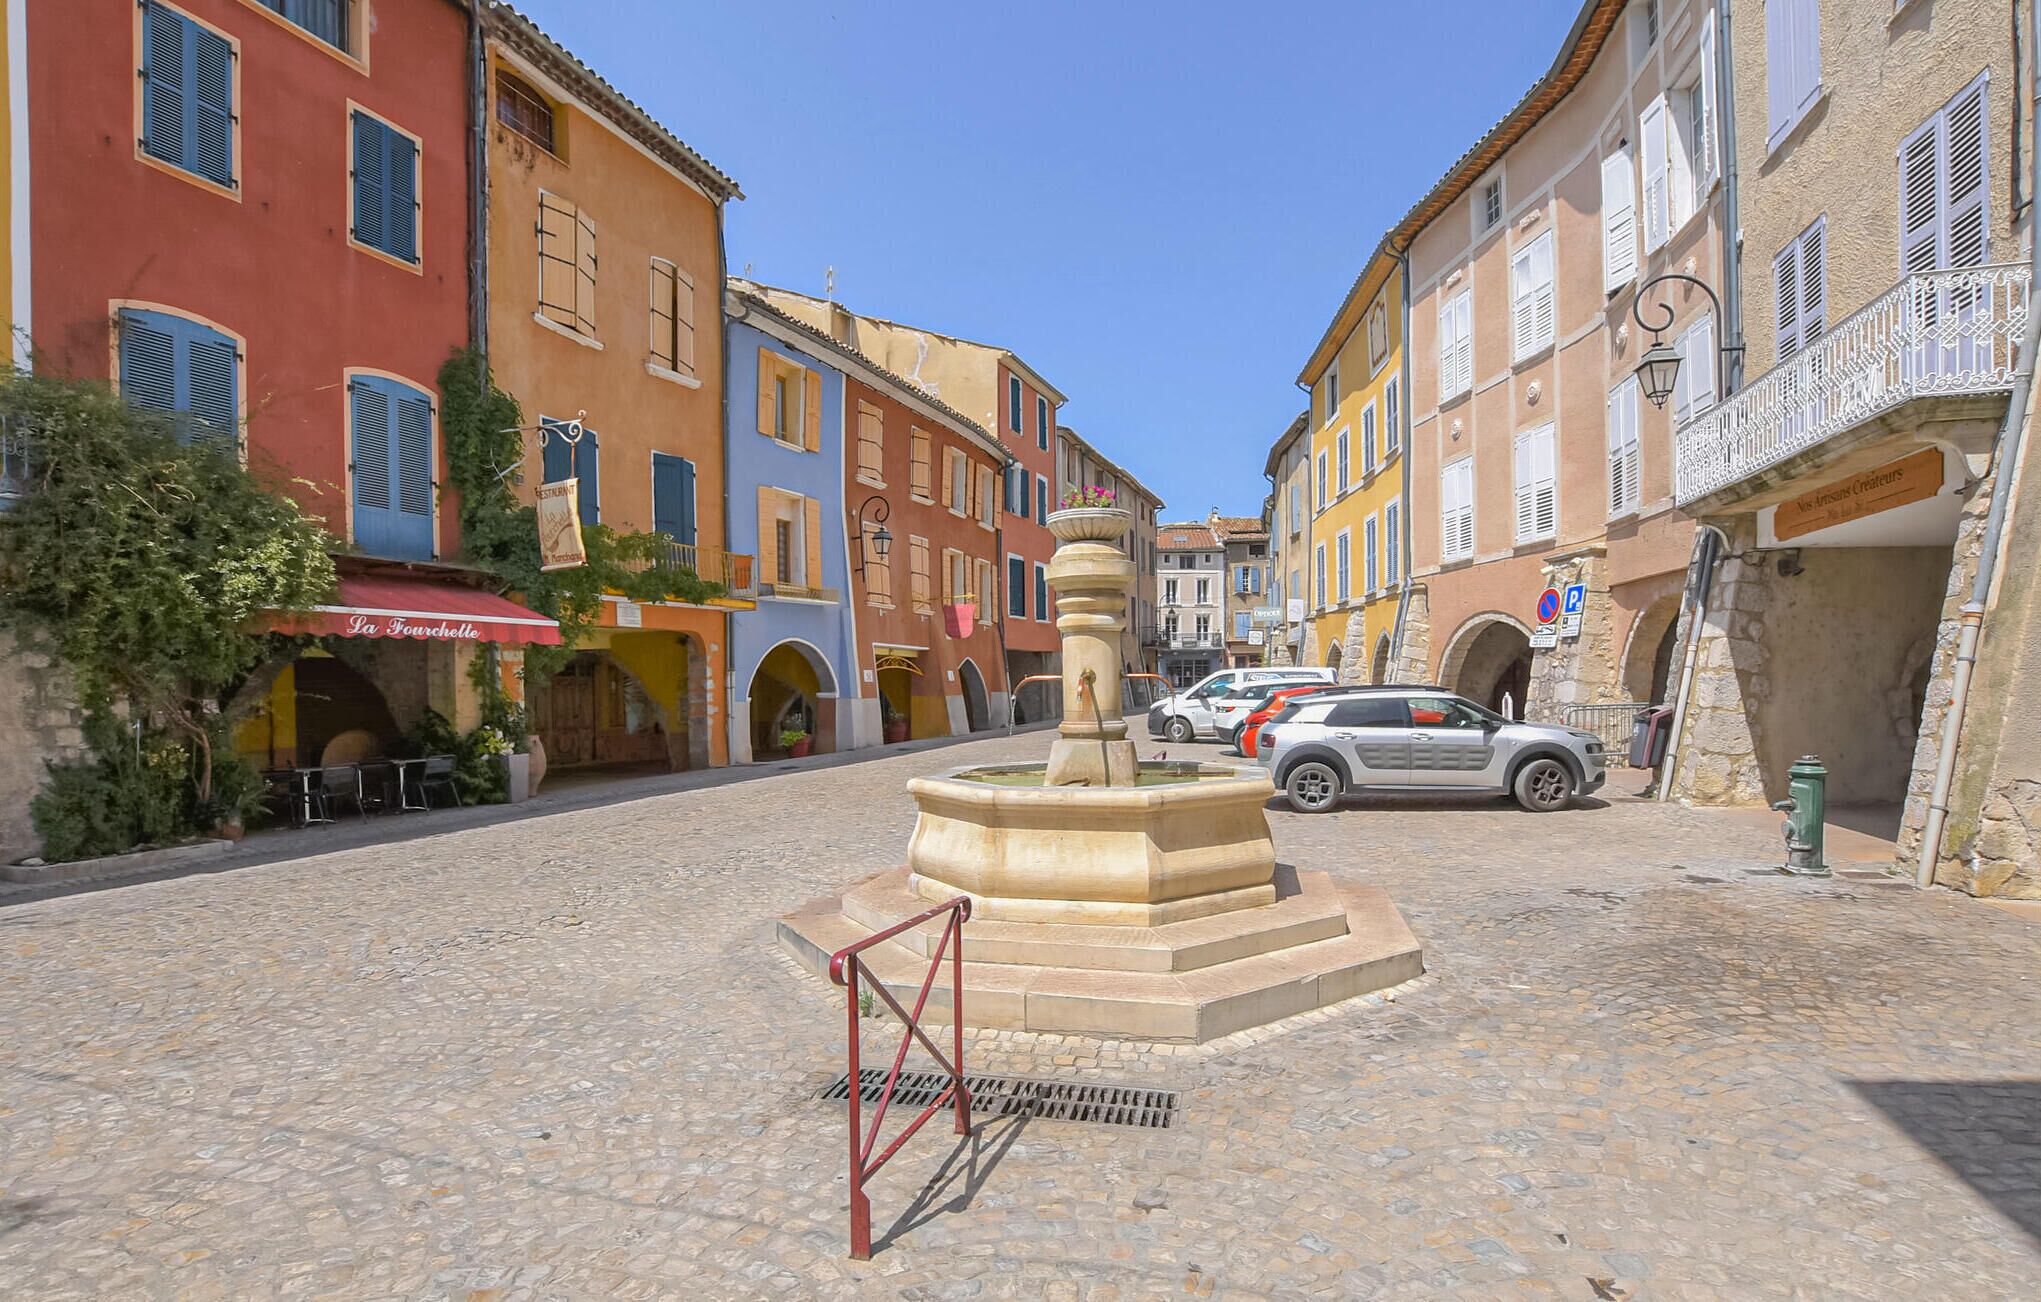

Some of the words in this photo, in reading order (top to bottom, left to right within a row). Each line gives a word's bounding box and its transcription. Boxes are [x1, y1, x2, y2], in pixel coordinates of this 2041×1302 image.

[1814, 486, 1851, 508] Artisans
[1568, 590, 1579, 609] P
[346, 615, 379, 634] La
[386, 616, 481, 638] Fourchette
